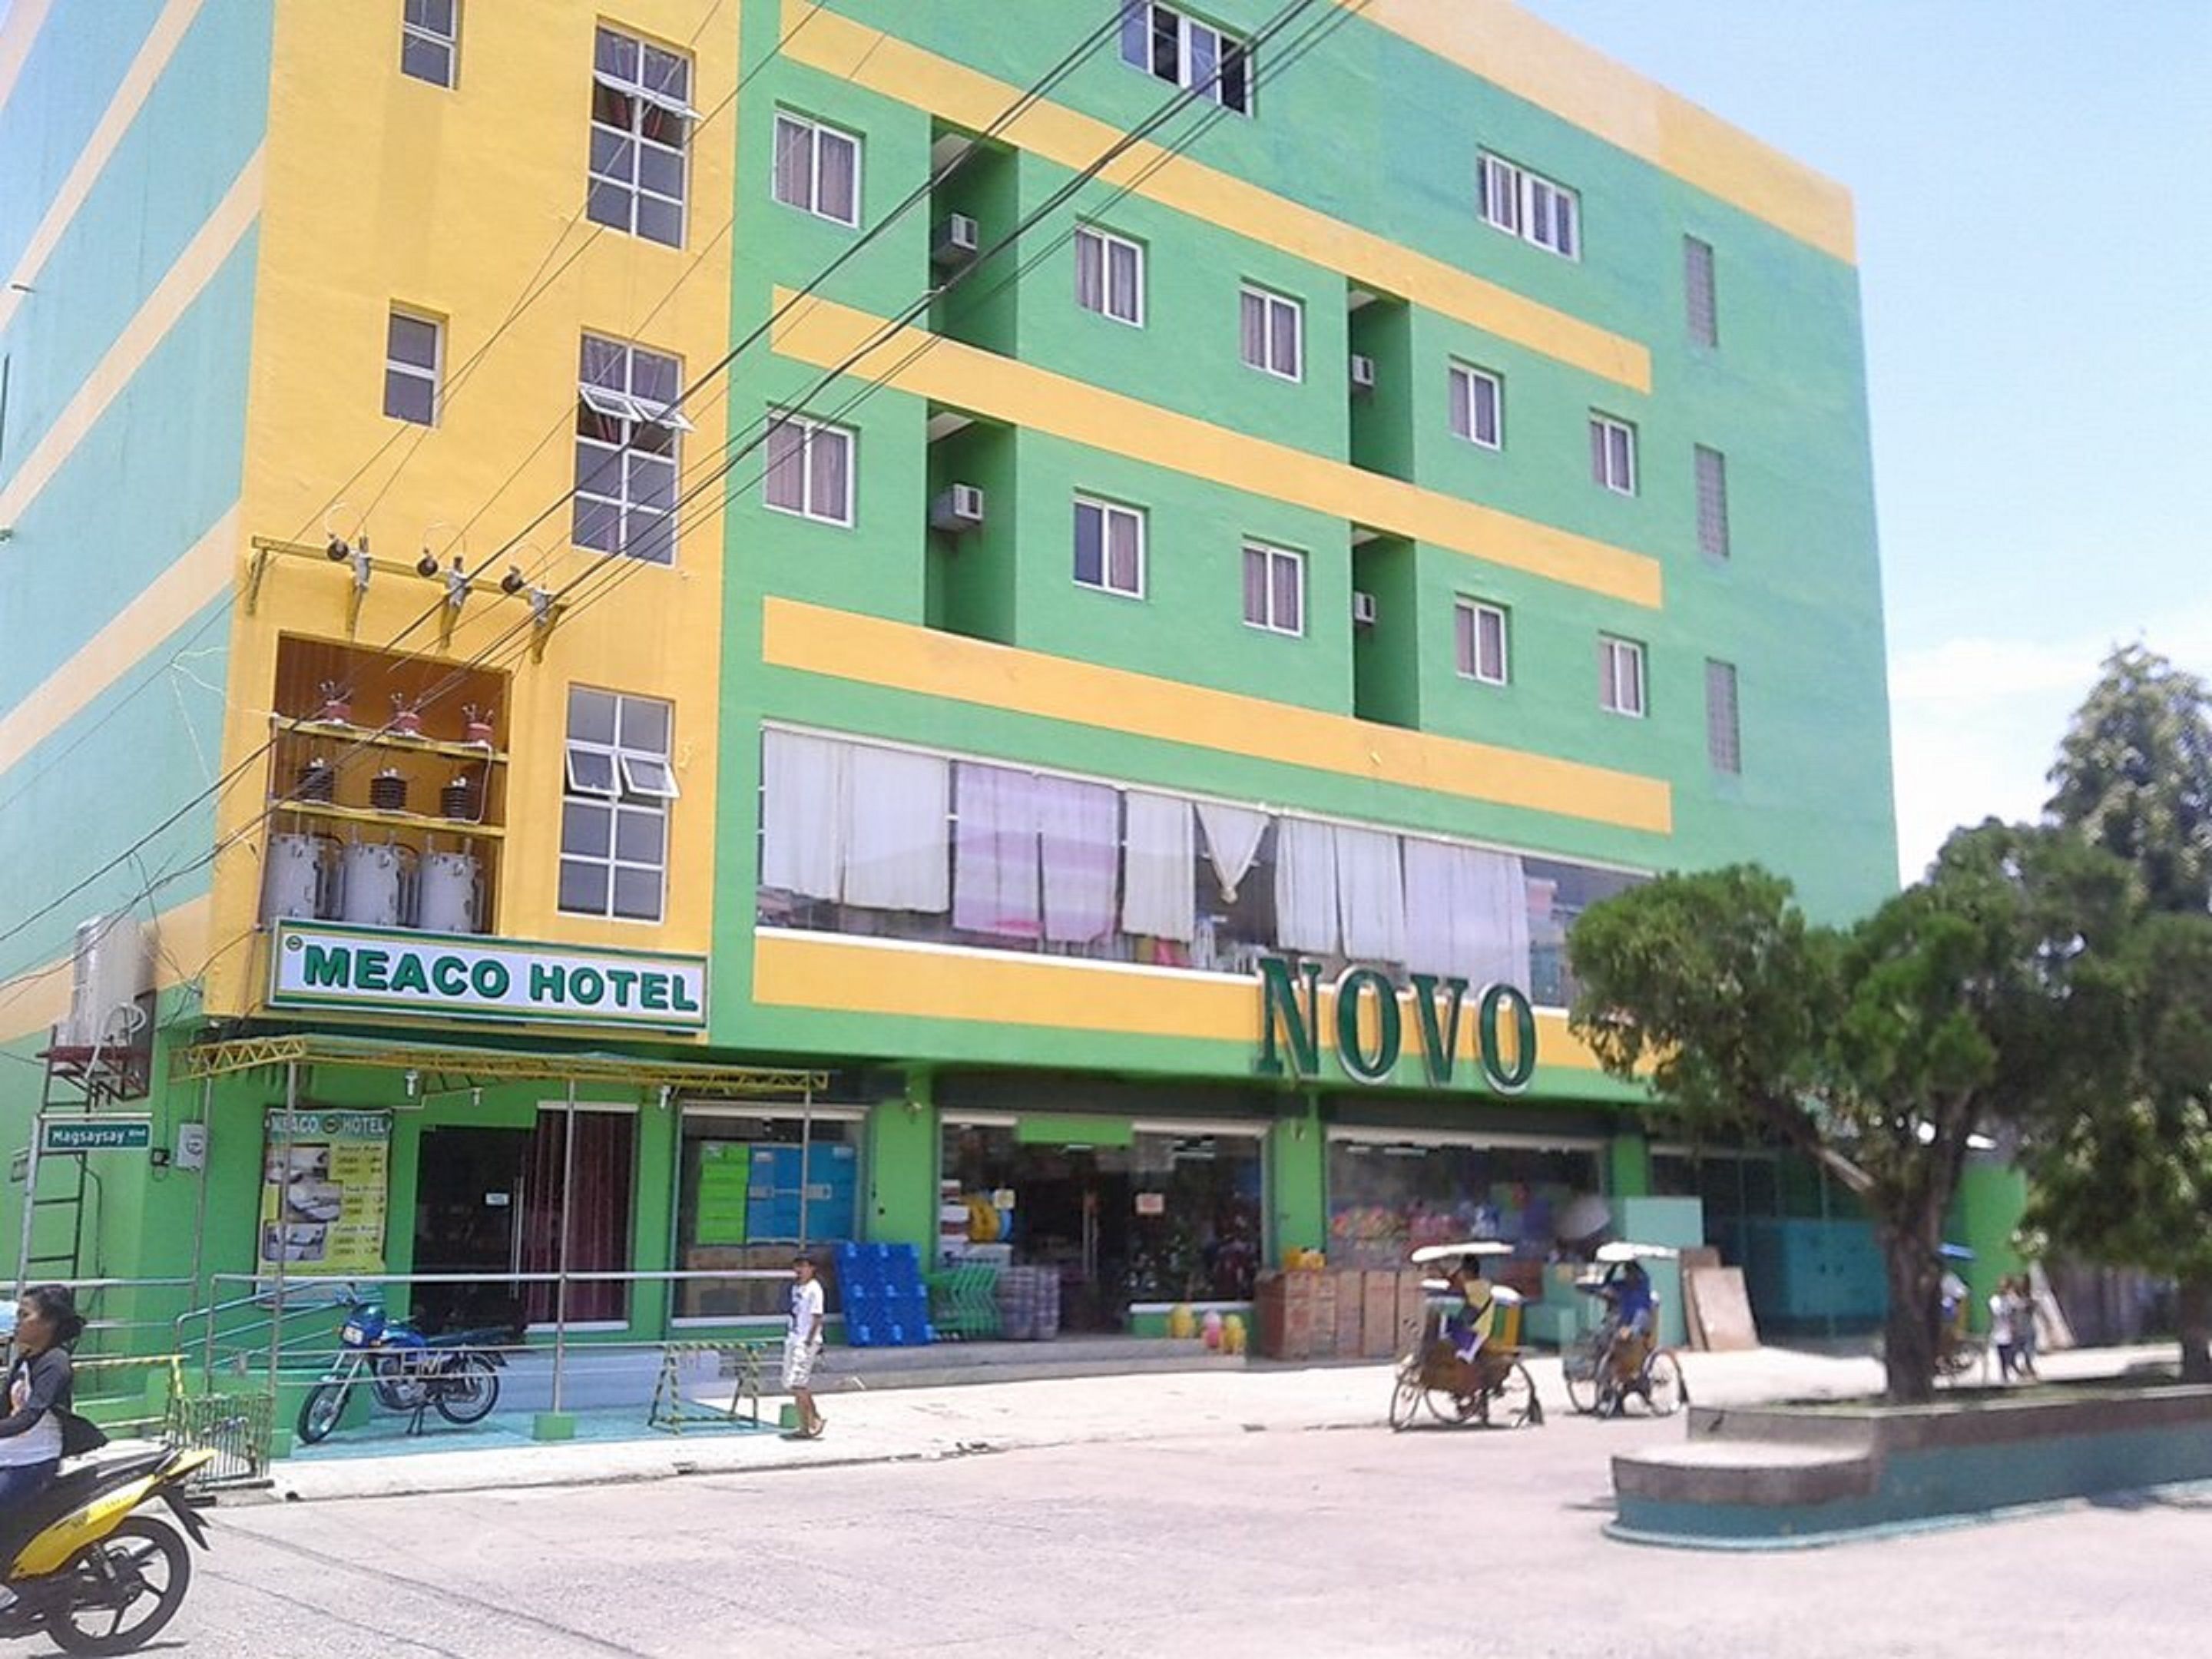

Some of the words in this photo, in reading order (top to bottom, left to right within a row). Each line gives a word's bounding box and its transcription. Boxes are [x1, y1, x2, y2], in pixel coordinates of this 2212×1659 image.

[303, 944, 511, 998] MEACO
[529, 963, 699, 1012] HOTEL
[1256, 957, 1538, 1096] NOVO
[51, 1129, 125, 1146] Magsaysay
[343, 1117, 385, 1133] HOTEL
